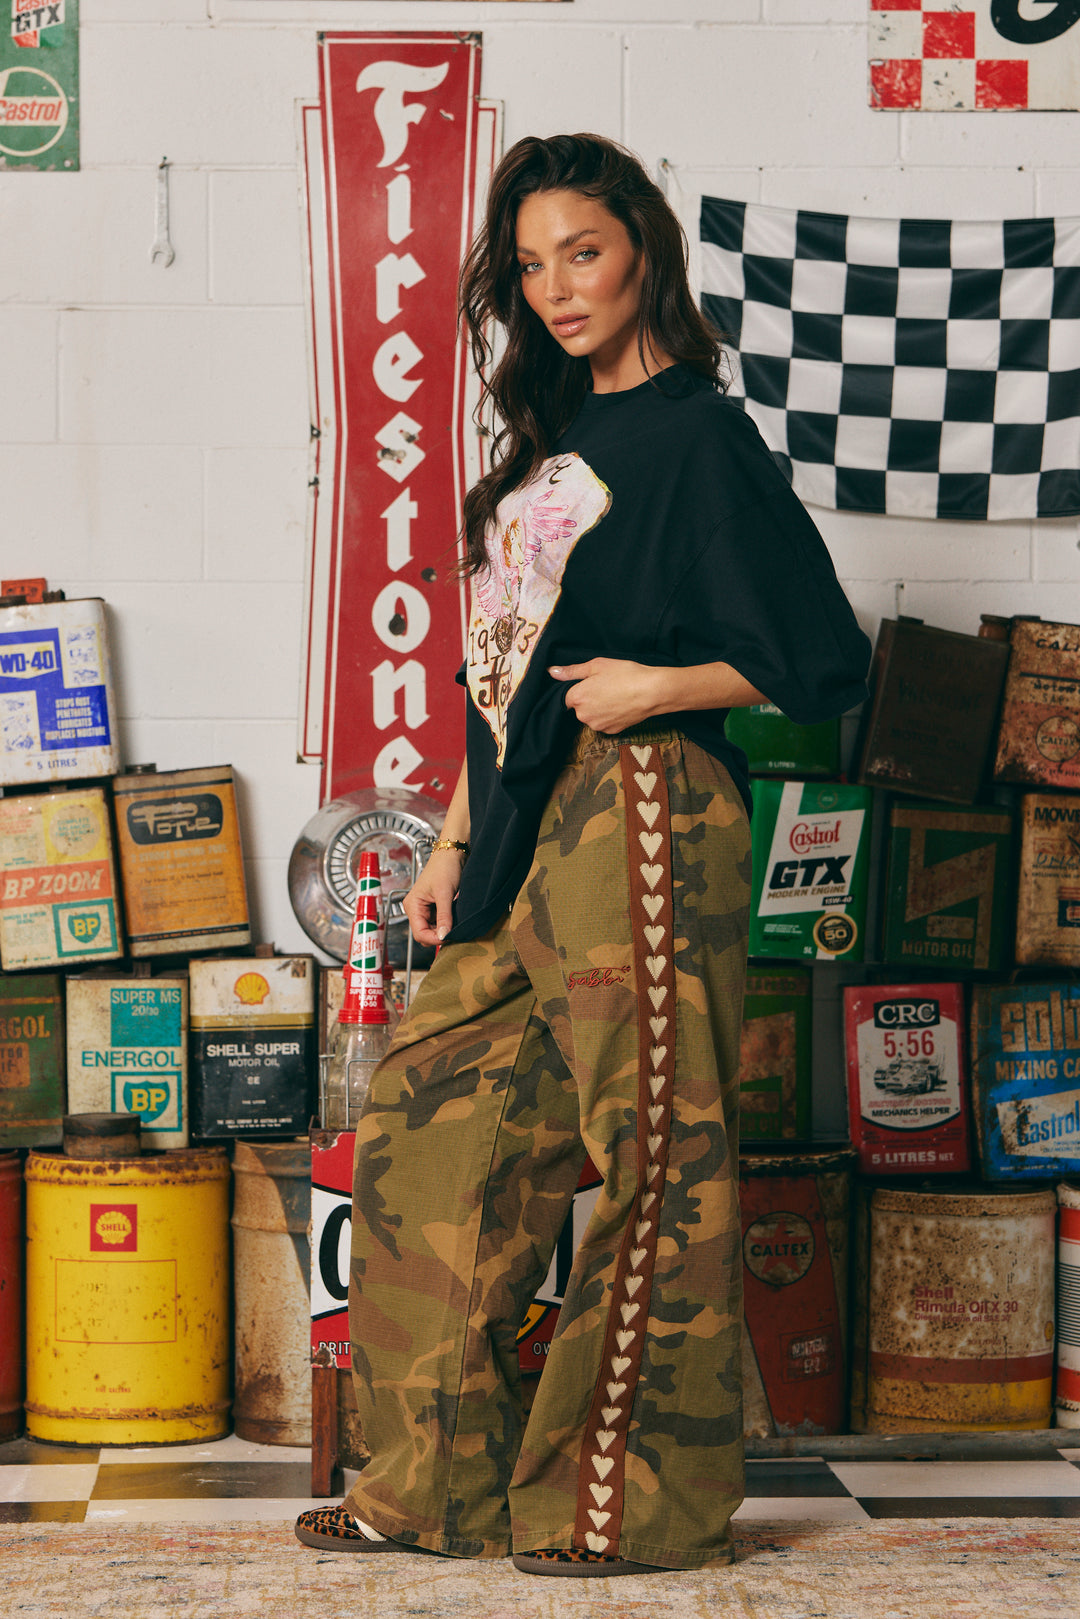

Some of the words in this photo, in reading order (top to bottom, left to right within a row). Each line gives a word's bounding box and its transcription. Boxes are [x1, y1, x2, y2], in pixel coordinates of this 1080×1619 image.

[15, 3, 61, 33] GTX
[356, 60, 451, 793] Firestone
[0, 650, 54, 674] WD-40
[37, 761, 43, 769] 5
[48, 758, 78, 769] LITRES
[789, 820, 841, 854] Castrol
[769, 855, 851, 889] GTX
[2, 877, 35, 900] BP
[37, 869, 104, 896] ZOOM
[767, 887, 808, 900] MODERN
[811, 885, 846, 897] ENGINE
[73, 918, 99, 937] BP
[824, 928, 847, 941] 50
[901, 939, 948, 957] MOTOR
[951, 942, 973, 959] OIL
[111, 991, 155, 1004] SUPER
[160, 990, 180, 1004] MS
[878, 1003, 935, 1025] CRC
[206, 1044, 251, 1057] SHELL
[254, 1042, 300, 1056] SUPER
[81, 1051, 182, 1068] ENERGOL
[228, 1058, 261, 1067] MOTOR
[264, 1058, 280, 1067] OIL
[995, 1059, 1058, 1082] MIXING
[130, 1088, 166, 1112] BP
[871, 1107, 918, 1118] MECHANICS
[920, 1106, 950, 1116] HELPER
[1016, 1100, 1080, 1147] Castrol
[872, 1153, 881, 1164] 5
[885, 1151, 936, 1164] LITRES
[101, 1223, 127, 1232] SHELL
[750, 1243, 809, 1257] CALTEX
[915, 1286, 953, 1299] Shell
[914, 1299, 965, 1313] Rimula
[1003, 1301, 1019, 1313] 30
